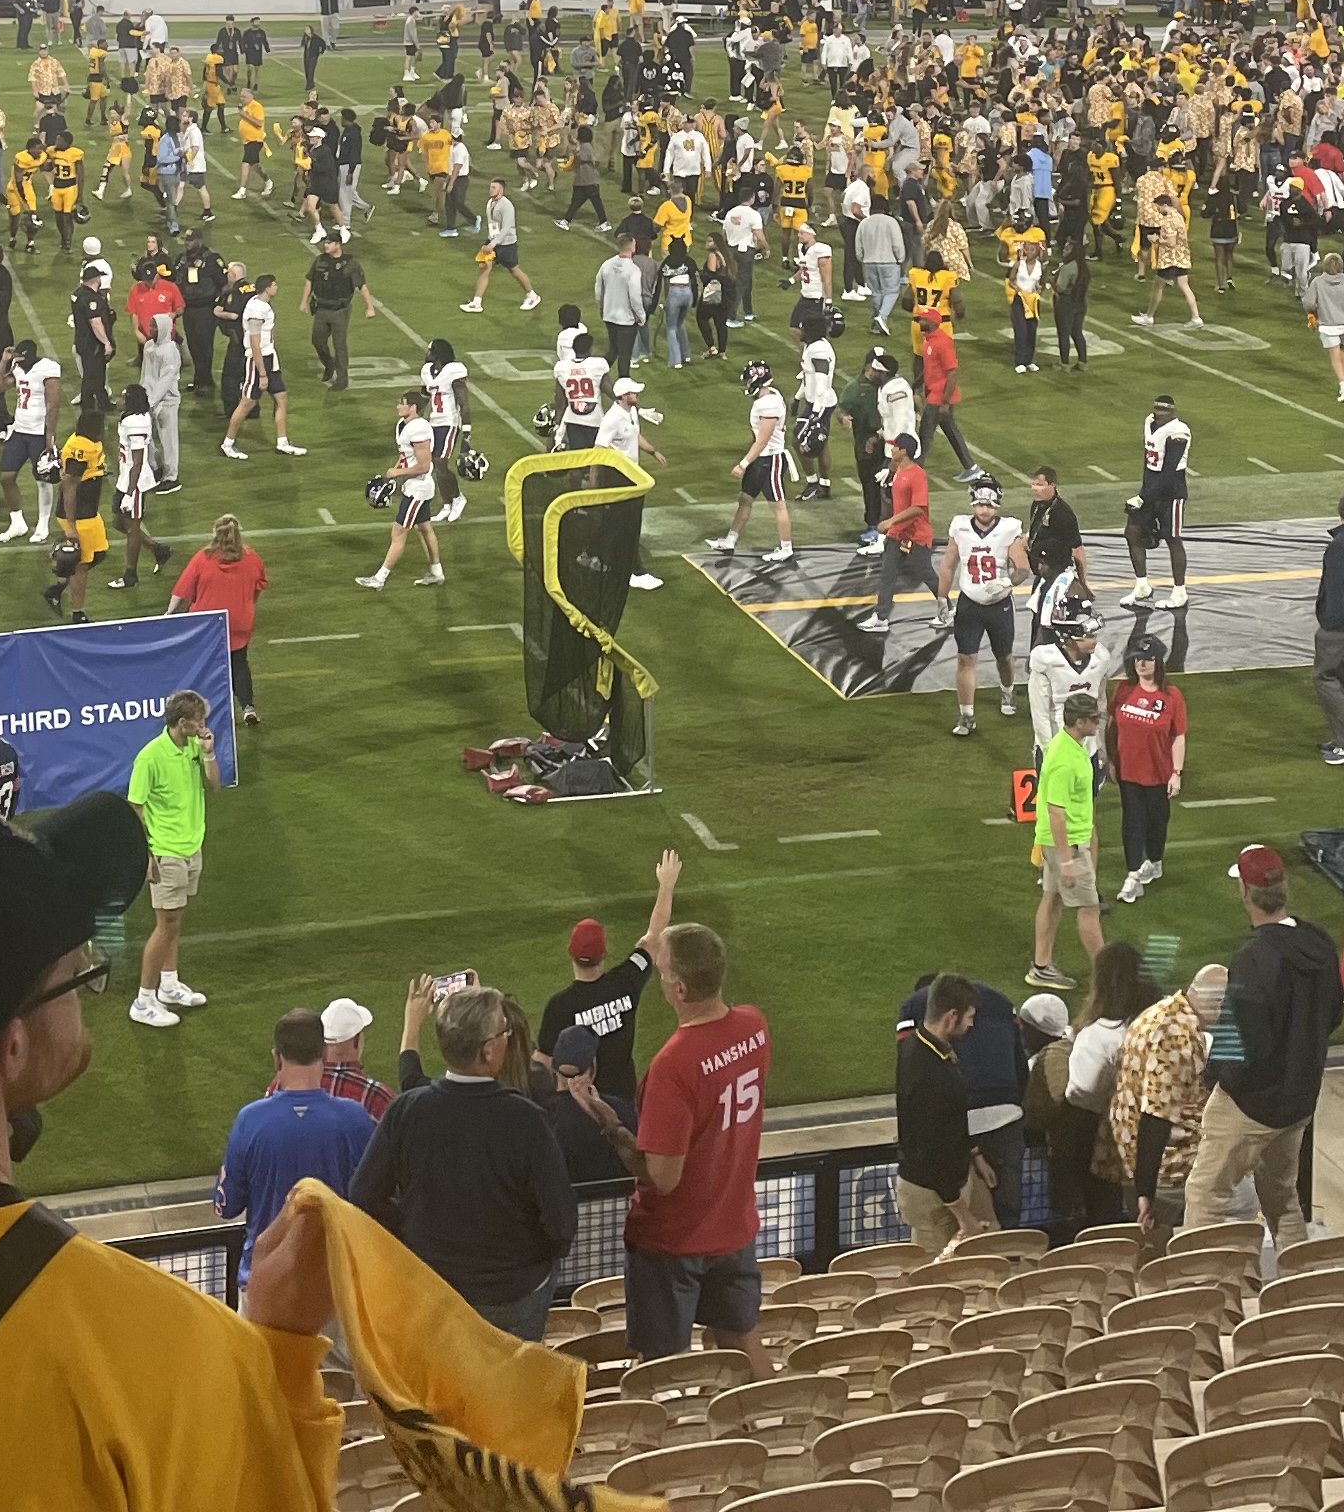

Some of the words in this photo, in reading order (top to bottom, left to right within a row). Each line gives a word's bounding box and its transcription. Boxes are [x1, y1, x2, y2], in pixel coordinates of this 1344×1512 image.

[783, 179, 804, 194] 32
[566, 377, 594, 400] 29
[966, 555, 996, 585] 49
[80, 696, 169, 726] STADIU
[1119, 703, 1161, 720] LIBERTY
[574, 994, 633, 1026] AMERICAN
[700, 1029, 766, 1076] HANSHAW
[718, 1067, 760, 1132] 15
